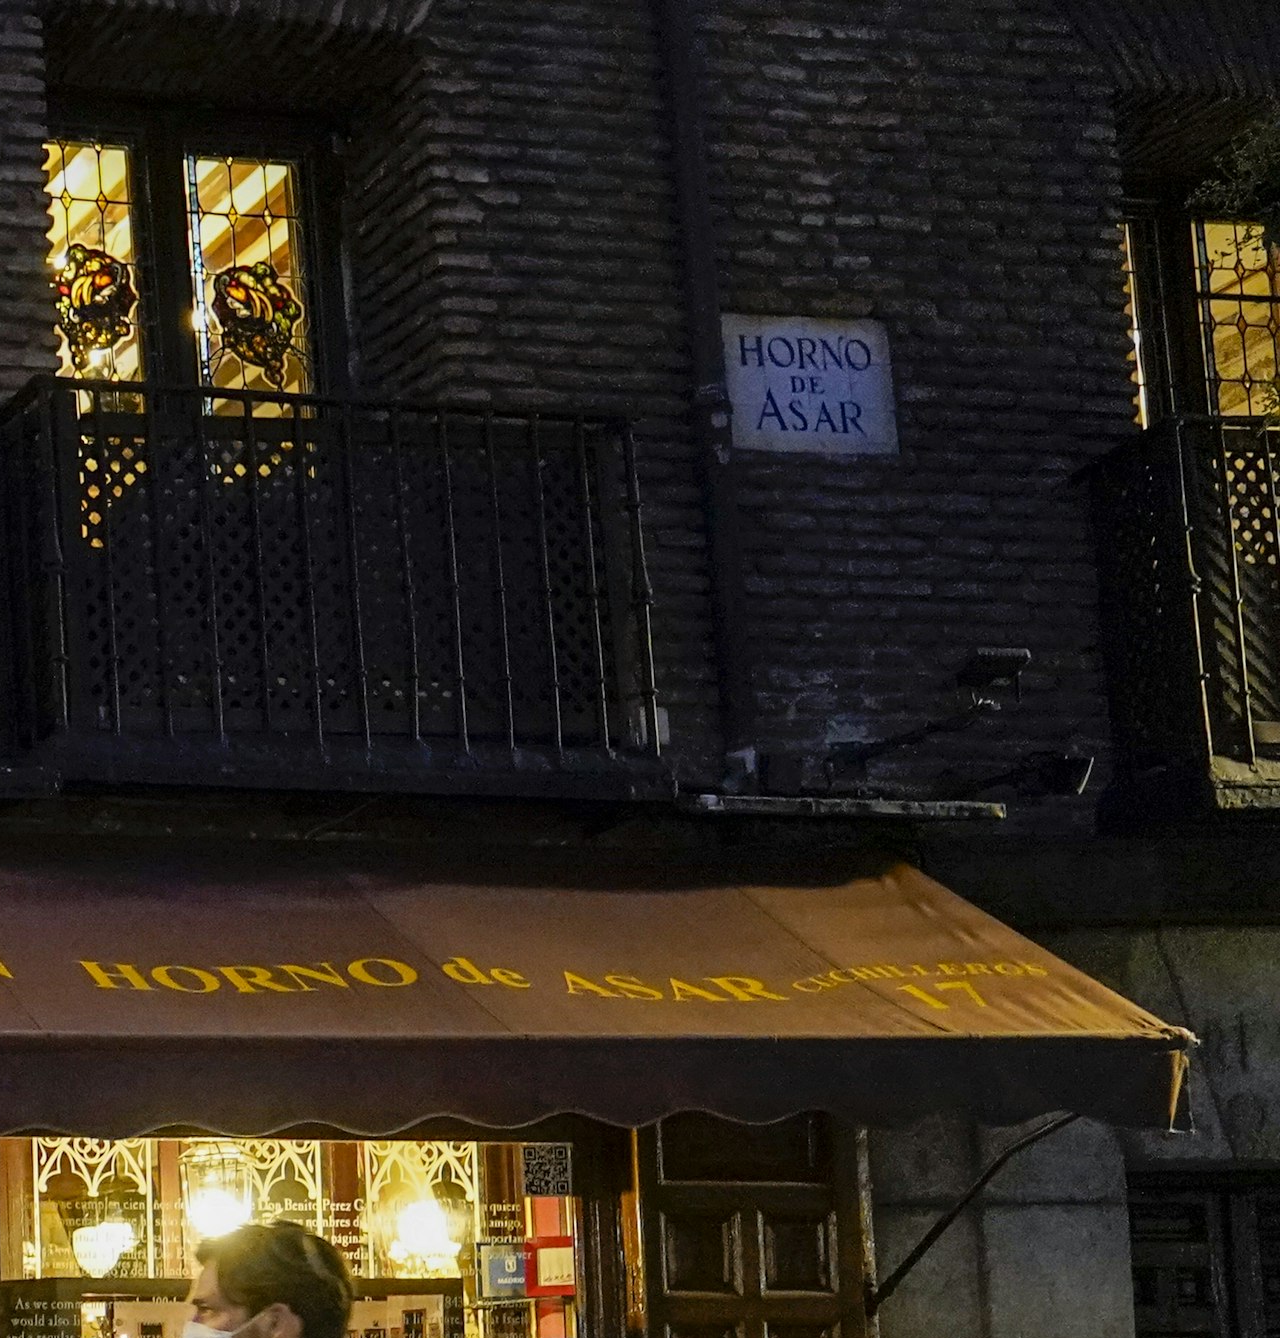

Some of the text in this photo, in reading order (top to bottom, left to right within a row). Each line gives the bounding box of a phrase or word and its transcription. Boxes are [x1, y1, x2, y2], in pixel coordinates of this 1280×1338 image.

[739, 333, 871, 371] HORNO
[790, 375, 825, 394] DE
[756, 389, 868, 436] ASAR
[79, 957, 419, 993] HORNO
[441, 956, 531, 989] de
[562, 967, 790, 1003] ASAR
[896, 980, 987, 1010] 17
[489, 1199, 521, 1216] quiere
[14, 1297, 30, 1310] As
[33, 1301, 48, 1310] we
[11, 1313, 44, 1326] would
[48, 1313, 70, 1326] also
